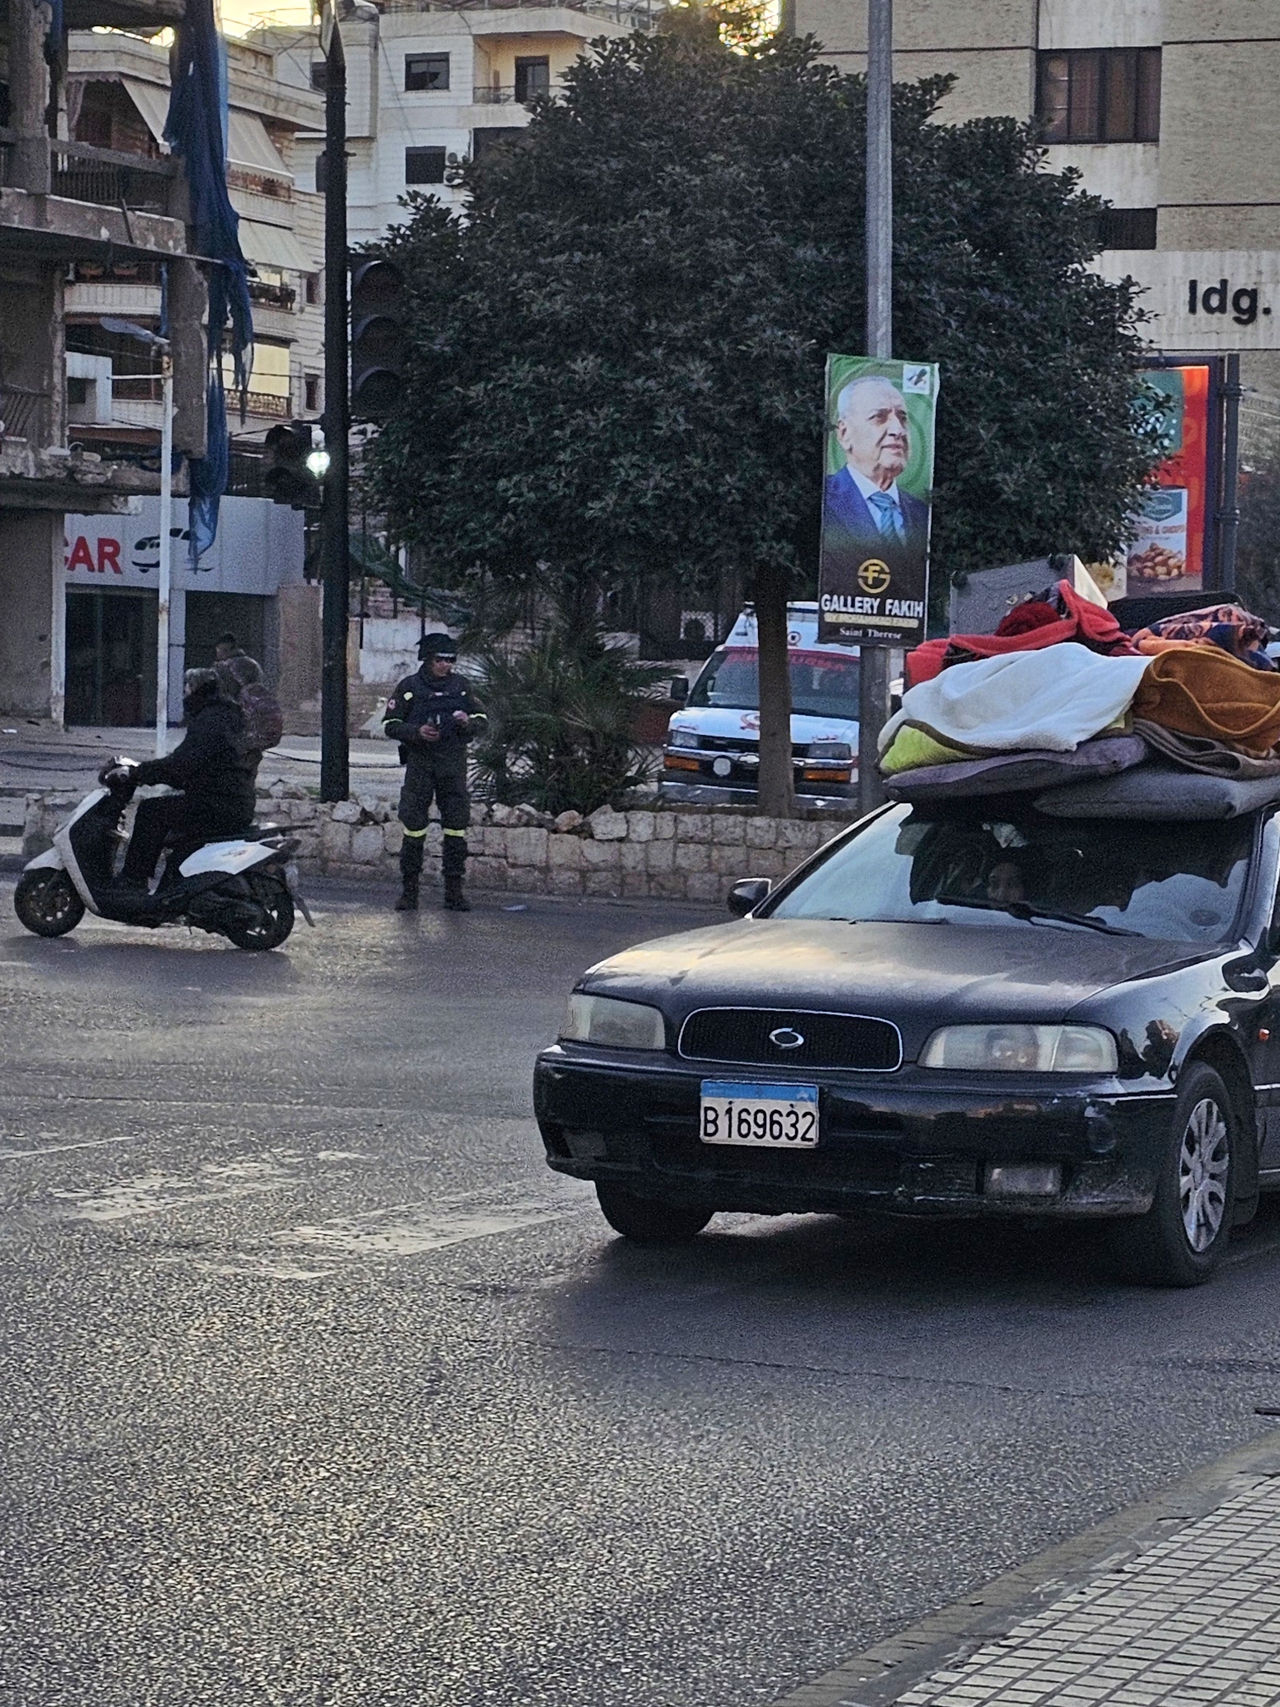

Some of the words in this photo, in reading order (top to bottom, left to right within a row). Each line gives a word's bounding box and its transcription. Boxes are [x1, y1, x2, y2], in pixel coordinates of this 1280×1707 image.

[63, 535, 123, 575] AR
[821, 593, 880, 614] GALLERY
[885, 599, 924, 617] FAKIH
[839, 626, 863, 637] Saint
